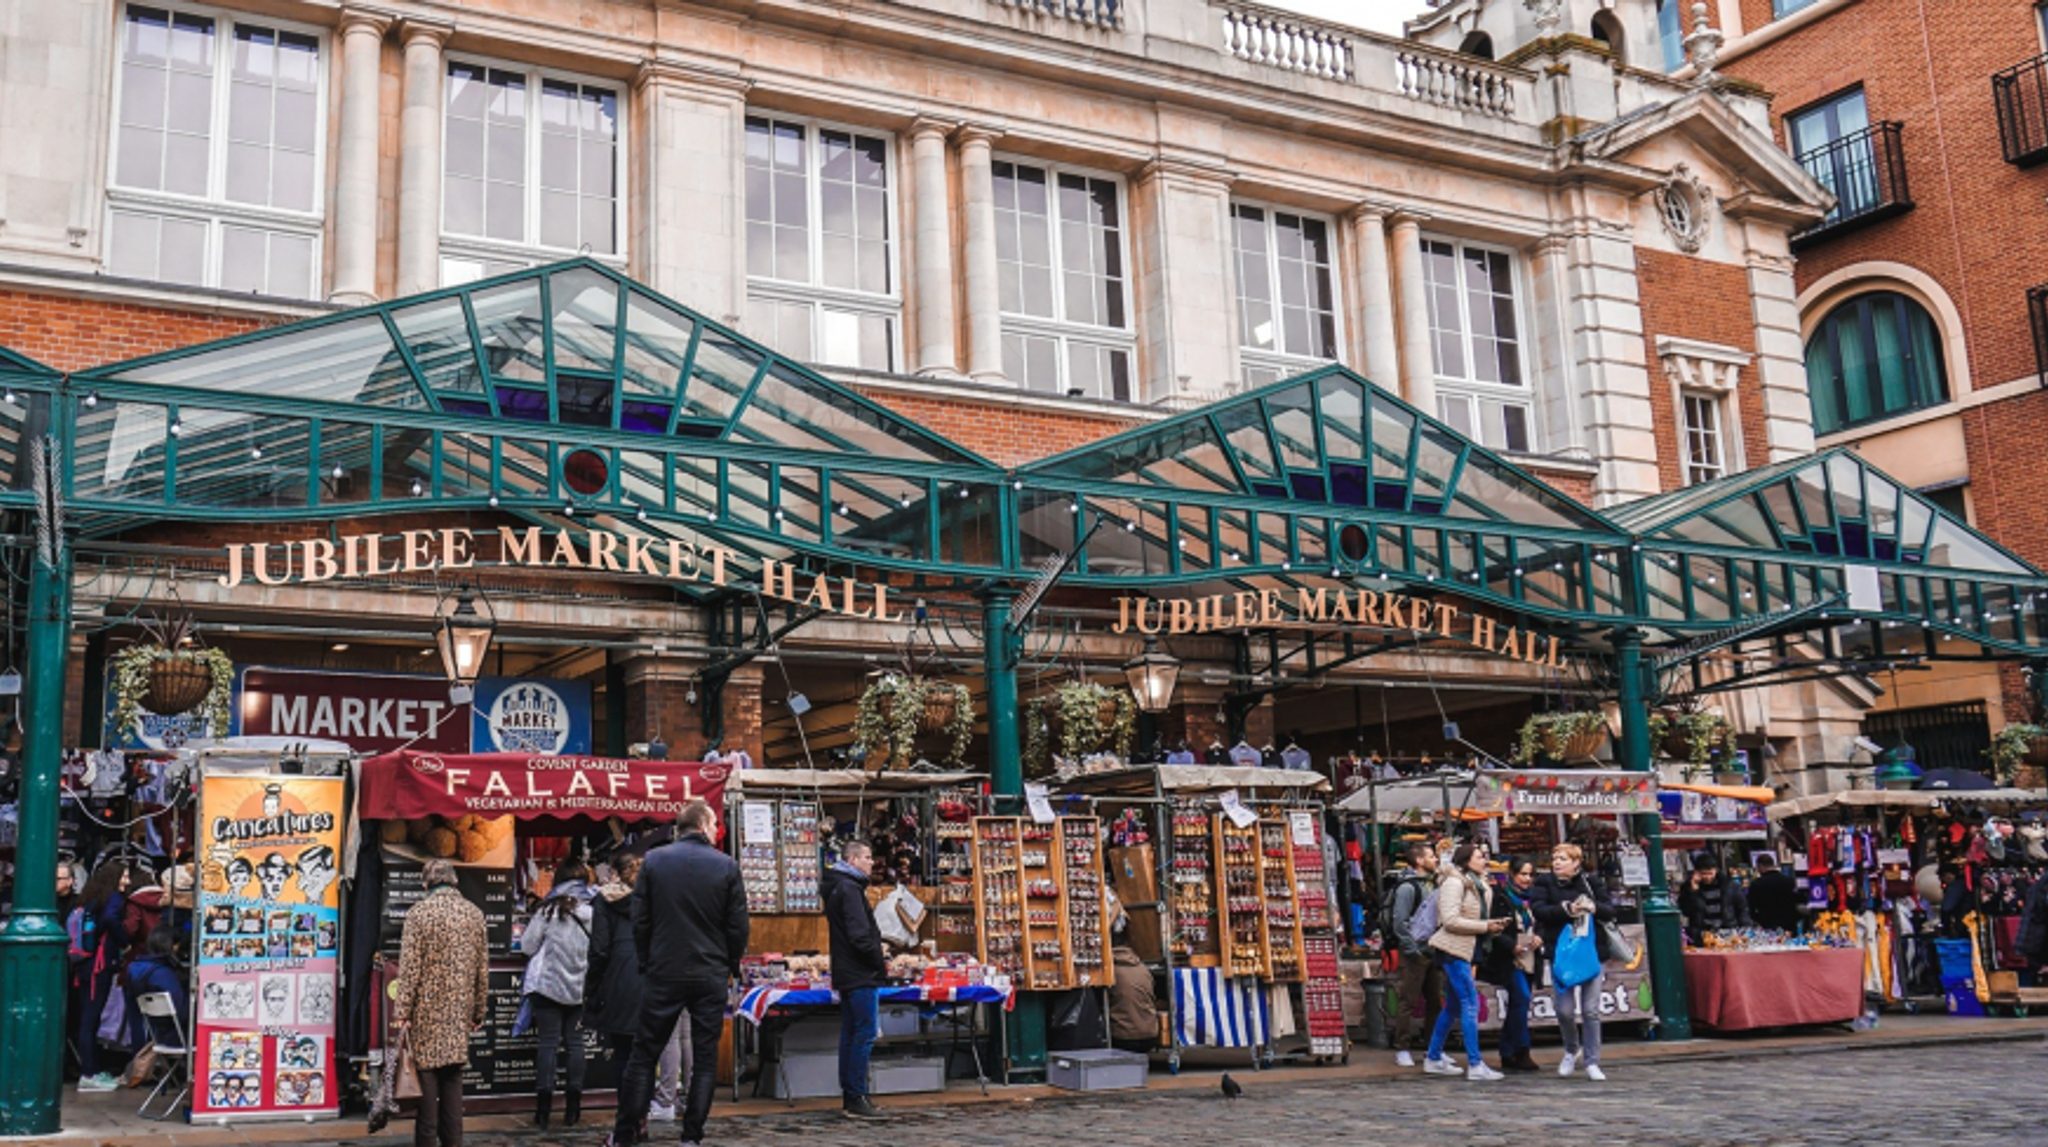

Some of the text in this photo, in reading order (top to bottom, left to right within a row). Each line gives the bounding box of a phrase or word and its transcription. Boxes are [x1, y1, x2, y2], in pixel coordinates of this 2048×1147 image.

[218, 526, 903, 622] JUBILEE MARKET HALL
[1112, 587, 1568, 670] JUBILEE MARKET HALL
[271, 694, 444, 740] MARKET
[502, 711, 556, 729] MARKET
[527, 758, 628, 772] COVENT GARDEN
[446, 768, 705, 802] FALAFEL
[1517, 789, 1618, 807] Fruit Market
[464, 796, 542, 809] VEGETARIAN
[561, 798, 654, 813] MEDITERRANEAN
